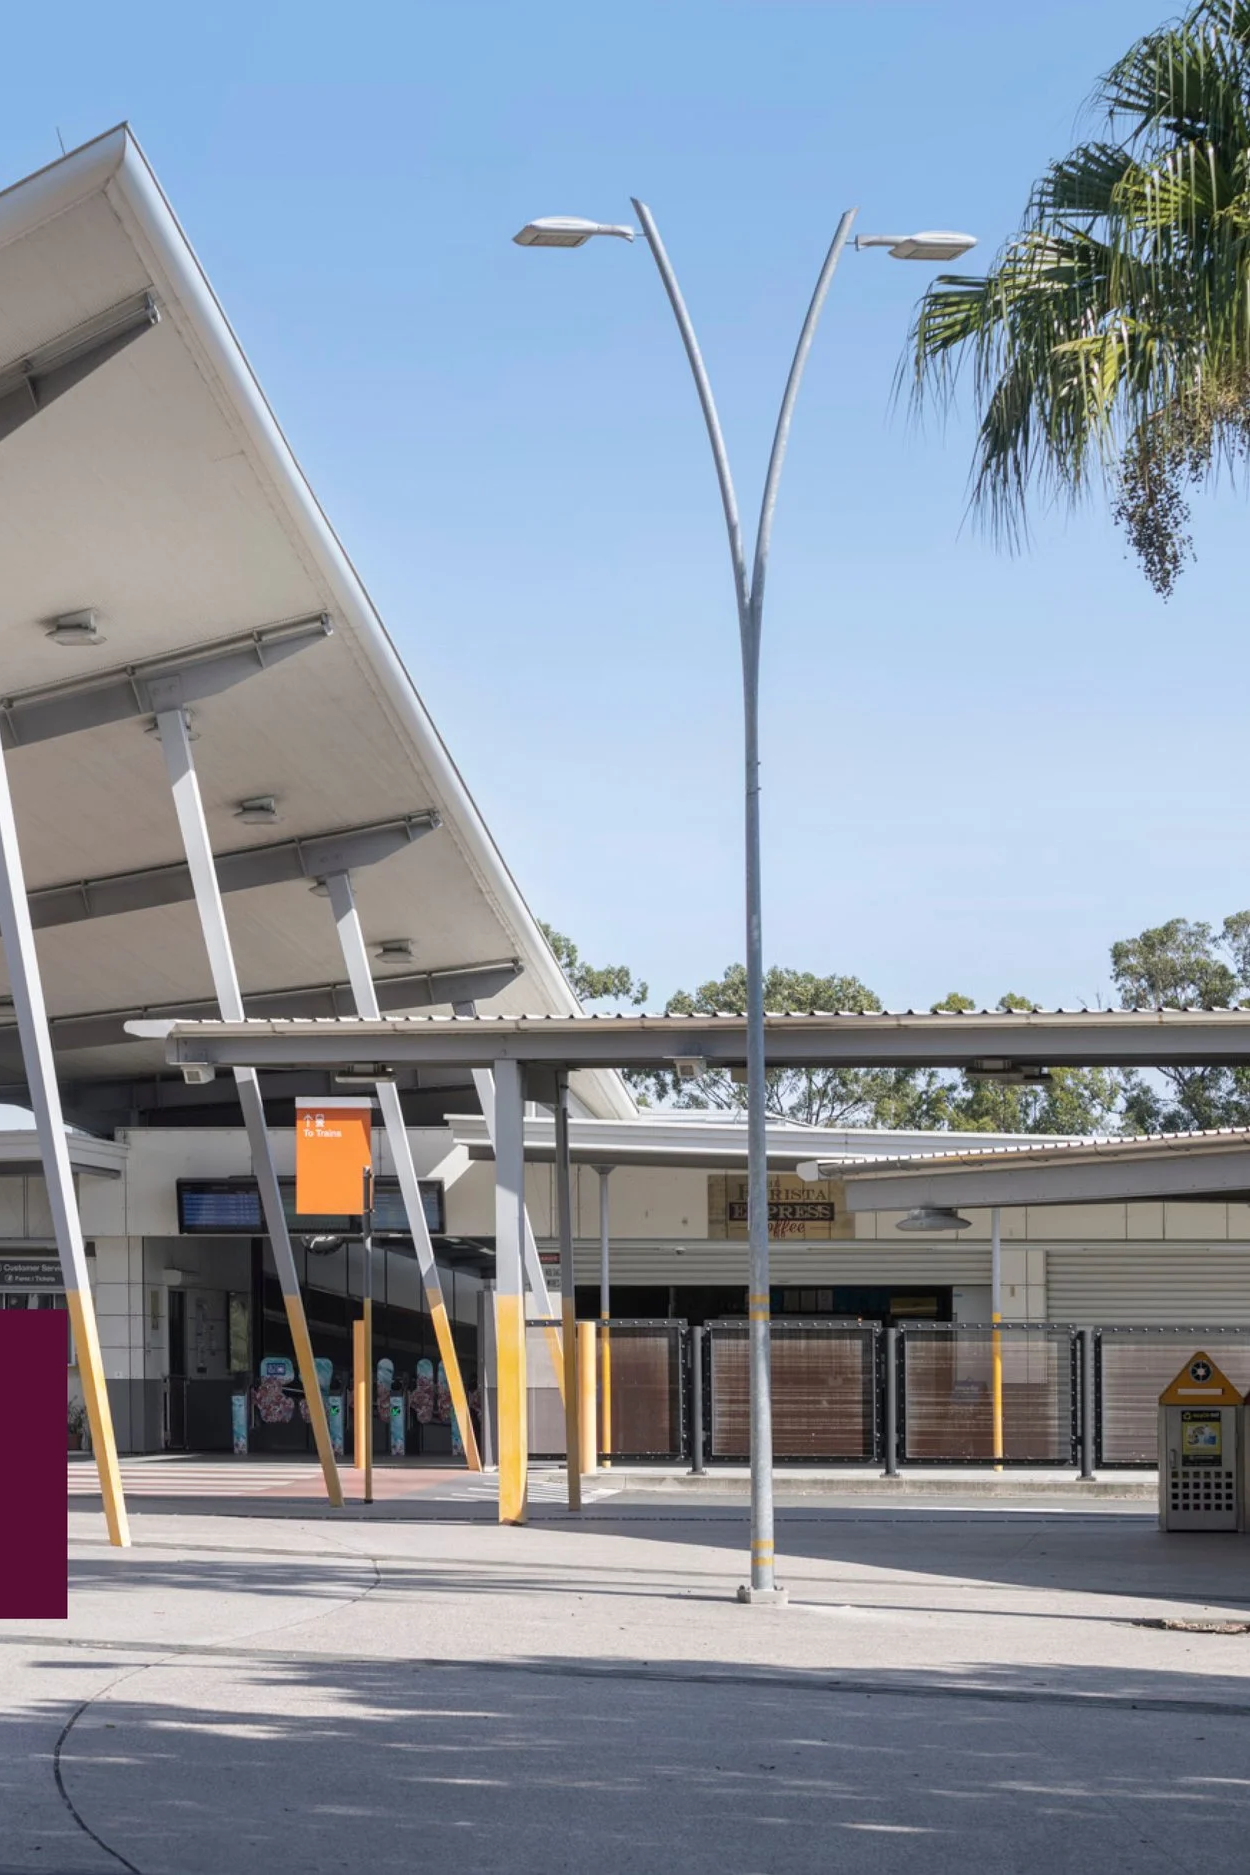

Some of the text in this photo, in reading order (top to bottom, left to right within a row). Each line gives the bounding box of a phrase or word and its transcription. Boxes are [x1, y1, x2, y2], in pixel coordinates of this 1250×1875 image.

[303, 1129, 342, 1137] To Trains
[736, 1183, 827, 1201] BRISTA
[733, 1205, 831, 1218] EPRESS
[767, 1219, 806, 1239] offee
[3, 1264, 39, 1272] Customer
